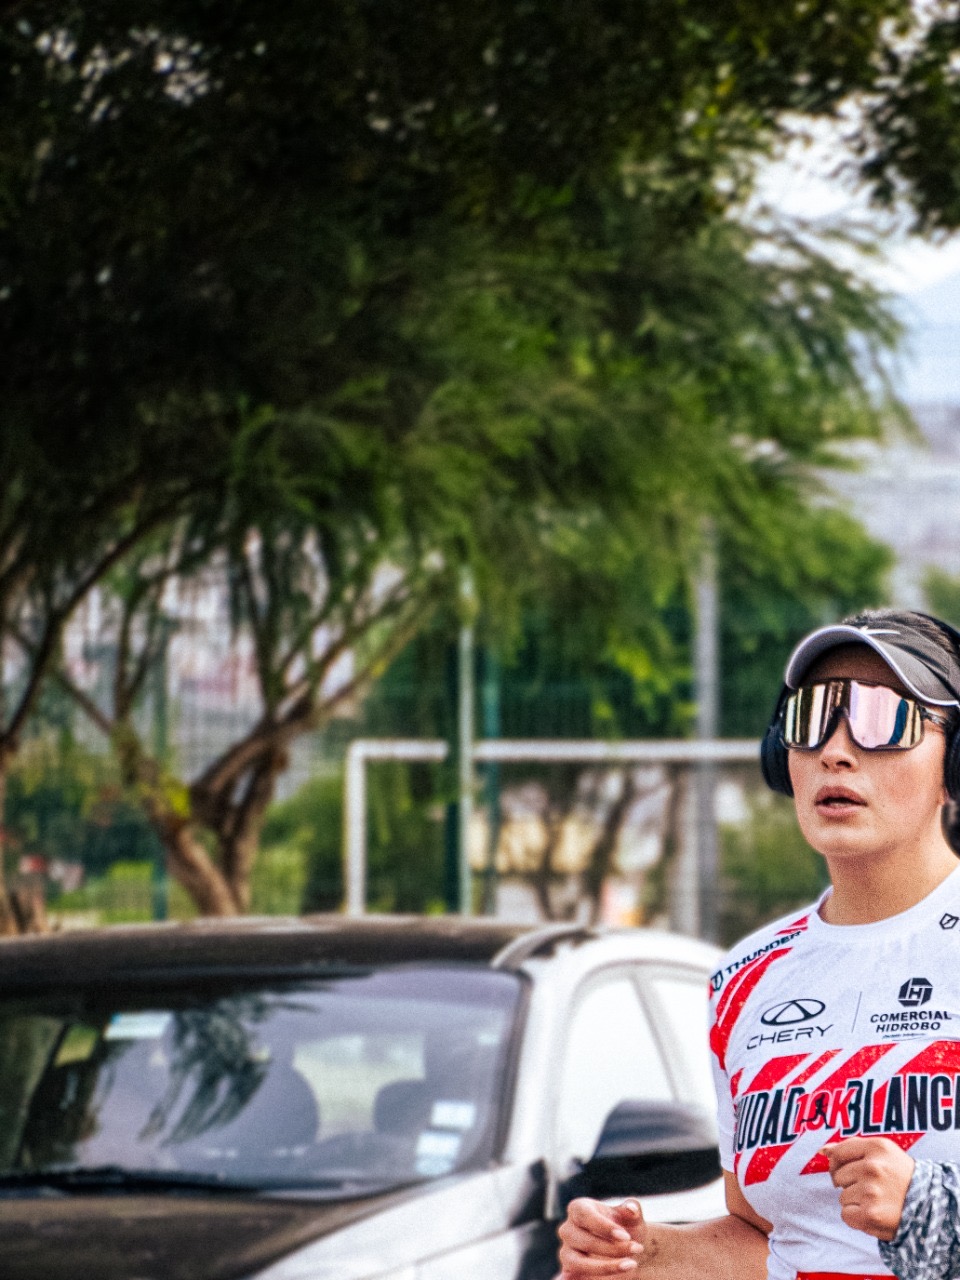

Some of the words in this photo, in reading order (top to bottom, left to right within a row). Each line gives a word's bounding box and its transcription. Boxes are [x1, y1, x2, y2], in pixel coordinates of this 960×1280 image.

[725, 930, 802, 974] THUNDER
[870, 1010, 952, 1023] COMERCIAL
[746, 1023, 834, 1050] CHERY
[876, 1021, 941, 1033] HIDROBO
